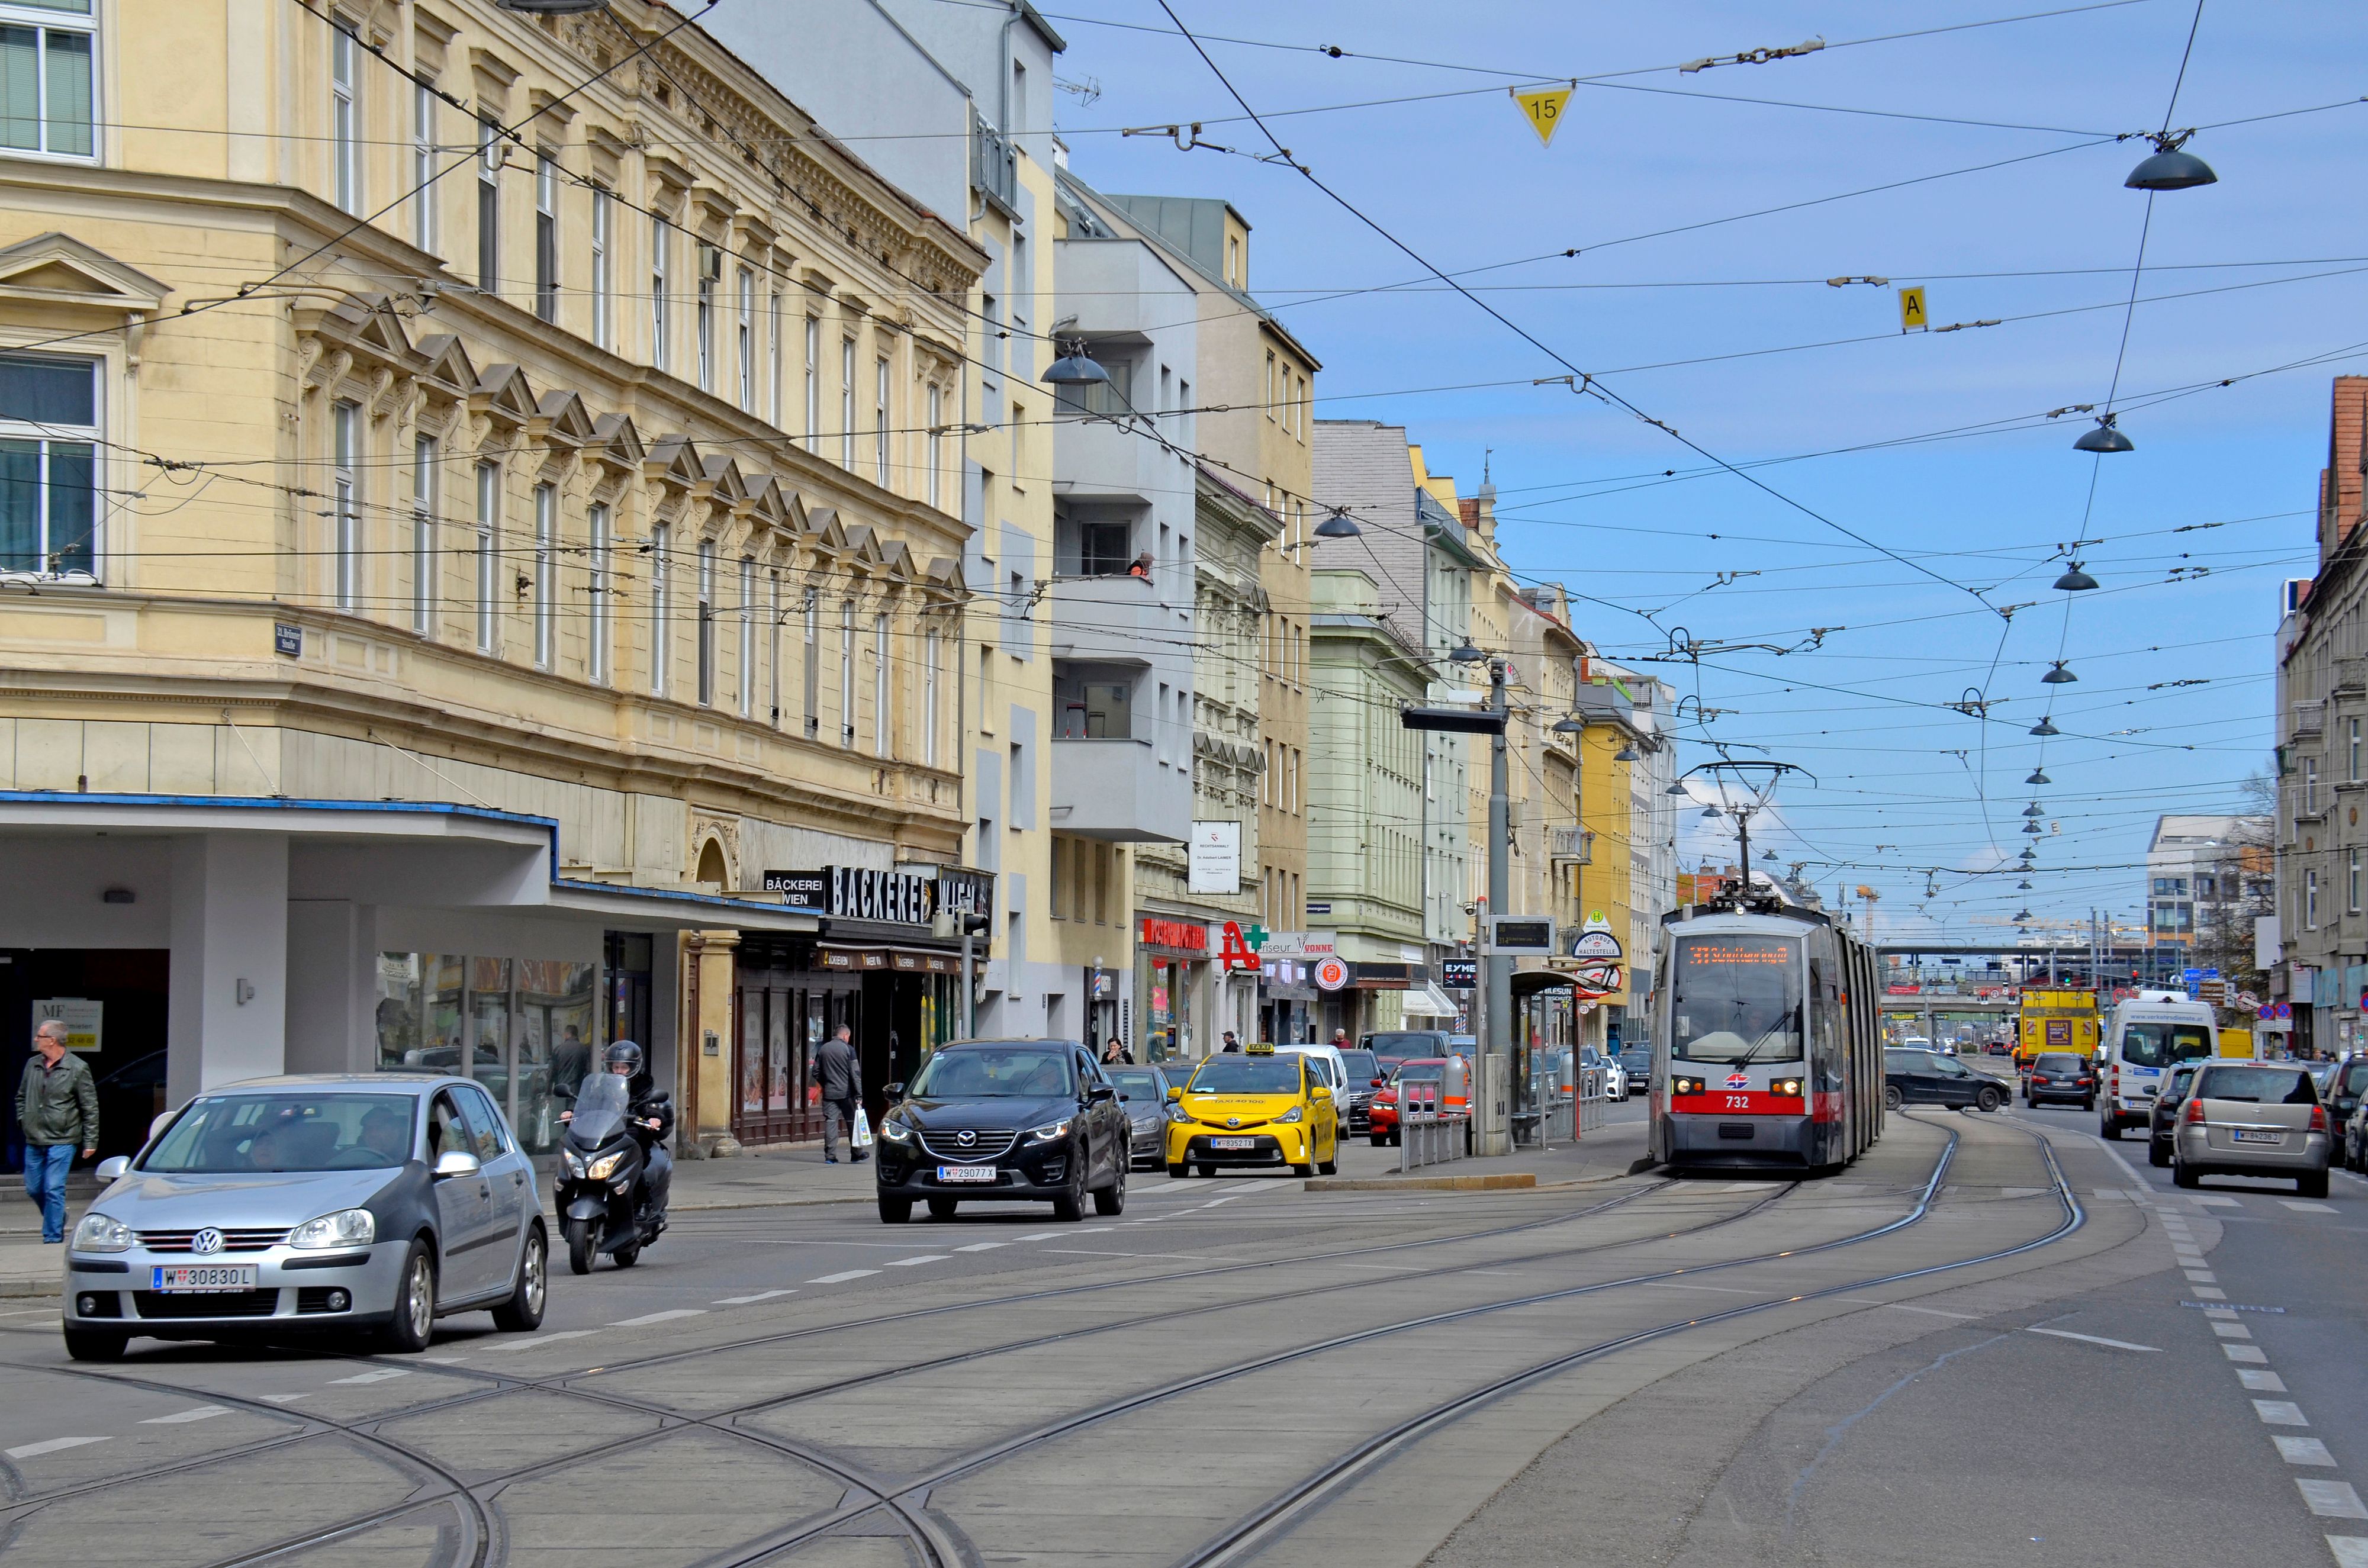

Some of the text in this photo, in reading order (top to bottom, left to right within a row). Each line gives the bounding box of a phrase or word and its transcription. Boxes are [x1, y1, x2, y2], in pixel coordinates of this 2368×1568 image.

[1532, 99, 1556, 119] 15
[1907, 295, 1920, 315] A
[2051, 822, 2059, 832] E
[766, 877, 822, 891] BÄCKEREI
[783, 894, 808, 904] WIEN
[1584, 935, 1611, 944] AUTOBUS
[42, 1004, 65, 1018] MF
[1726, 1096, 1749, 1108] 732
[945, 1168, 952, 1177] W
[958, 1168, 986, 1177] 29077
[165, 1270, 176, 1285] W
